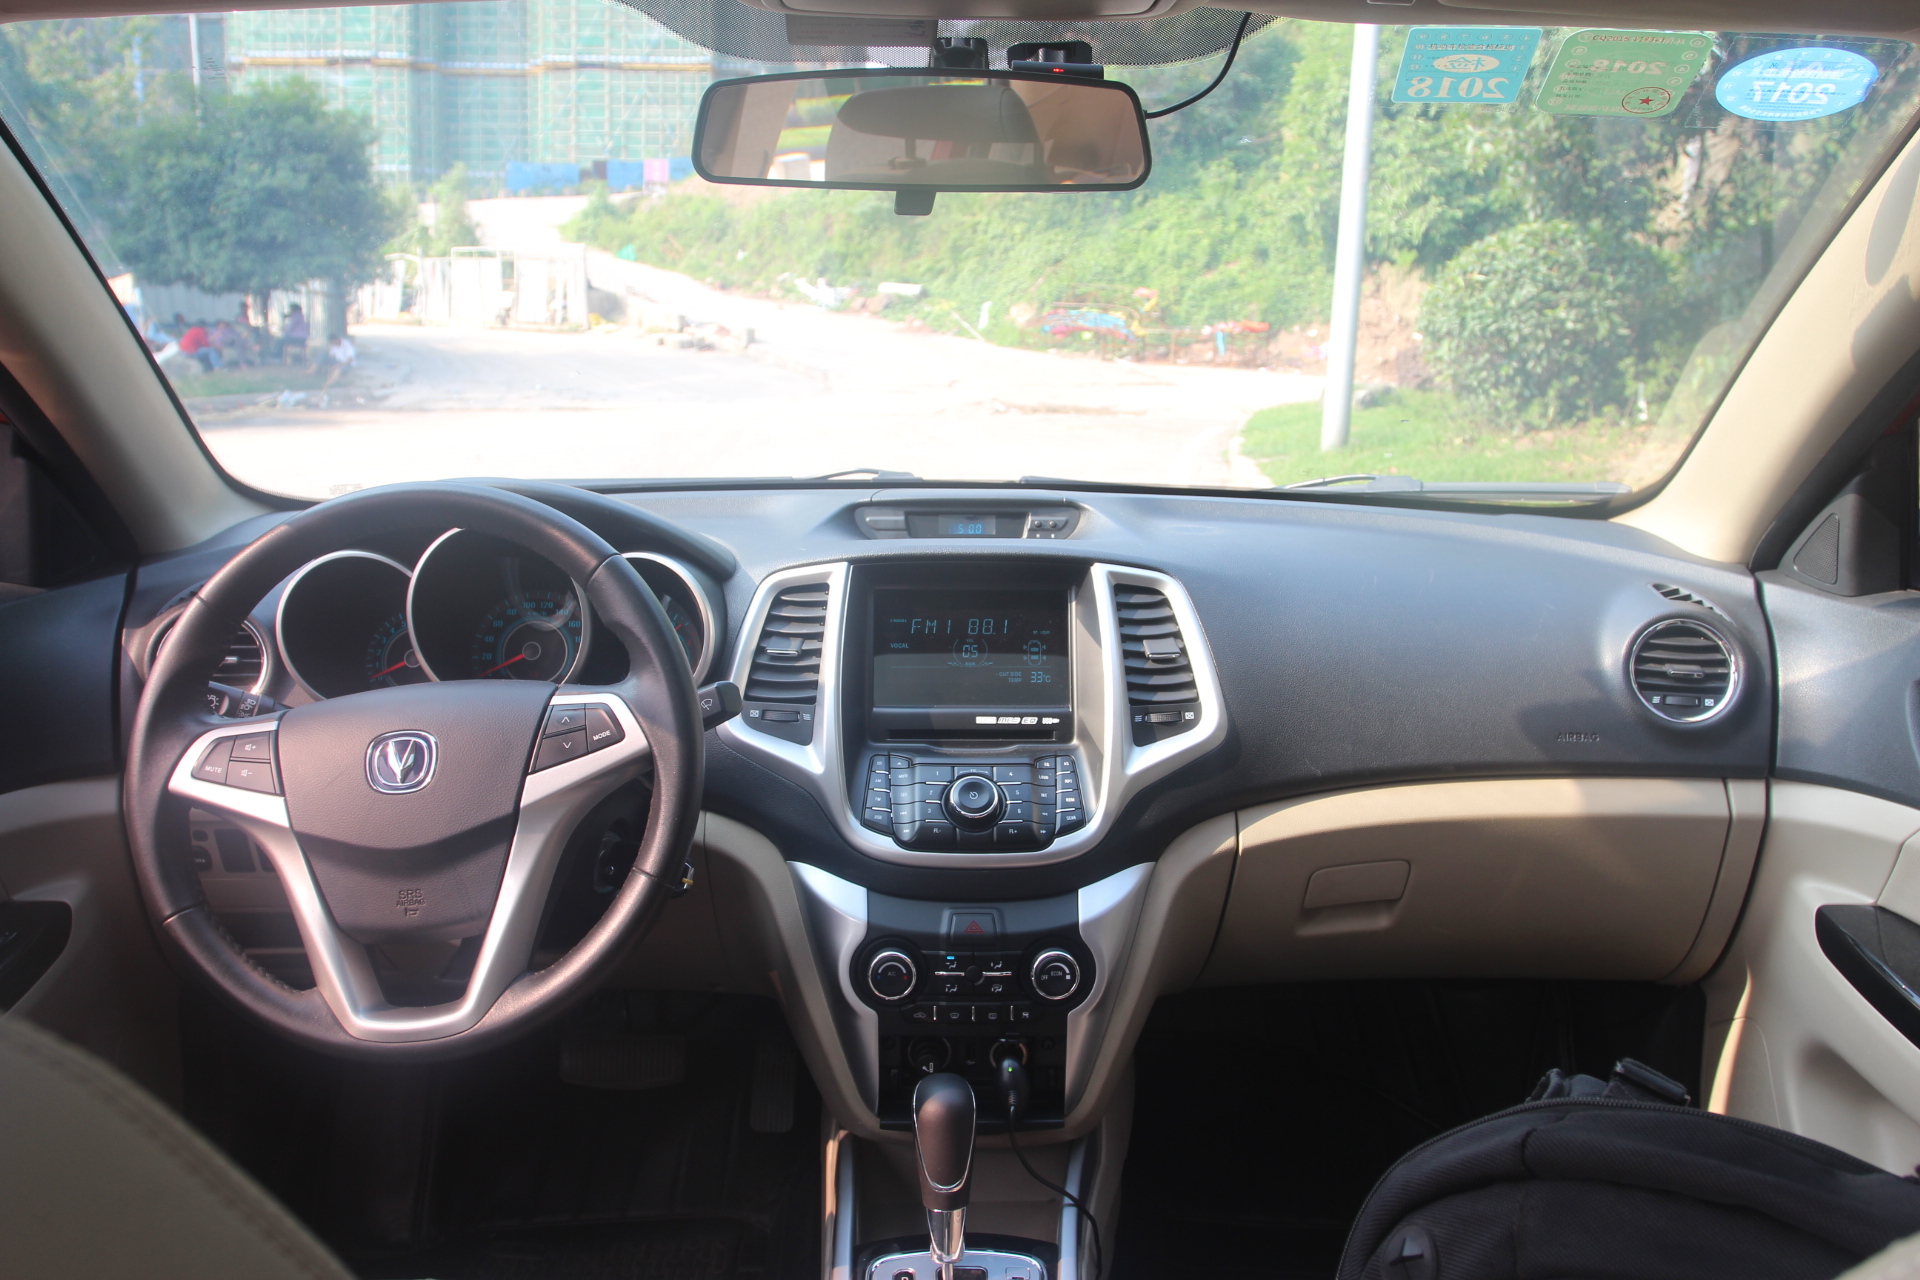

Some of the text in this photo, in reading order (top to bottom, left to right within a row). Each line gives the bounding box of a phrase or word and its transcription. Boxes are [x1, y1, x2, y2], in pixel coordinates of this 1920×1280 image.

[967, 618, 1009, 635] 88.1
[962, 644, 979, 658] 05
[592, 730, 611, 741] MODE
[1556, 731, 1600, 743] AIRBAG
[205, 765, 223, 774] MUTE
[398, 888, 423, 900] SRS
